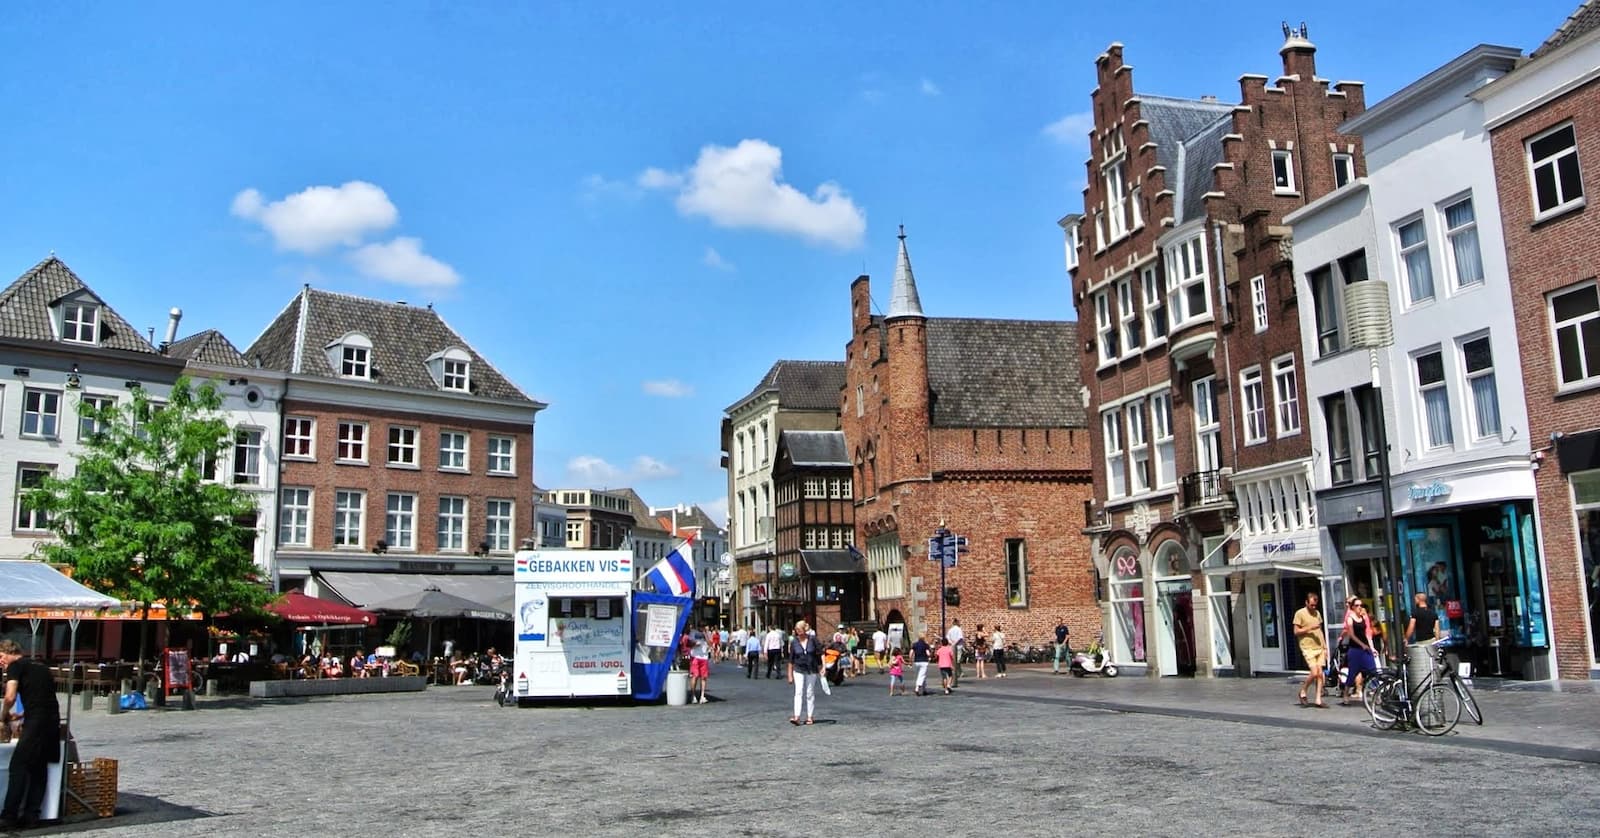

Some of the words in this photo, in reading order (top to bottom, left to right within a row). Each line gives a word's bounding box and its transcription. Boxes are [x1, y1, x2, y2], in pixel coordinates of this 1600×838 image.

[529, 560, 595, 573] GEBAKKEN
[599, 560, 618, 573] VIS
[526, 581, 621, 590] ZEEVISGROOTHANDEL
[601, 661, 624, 669] KROL
